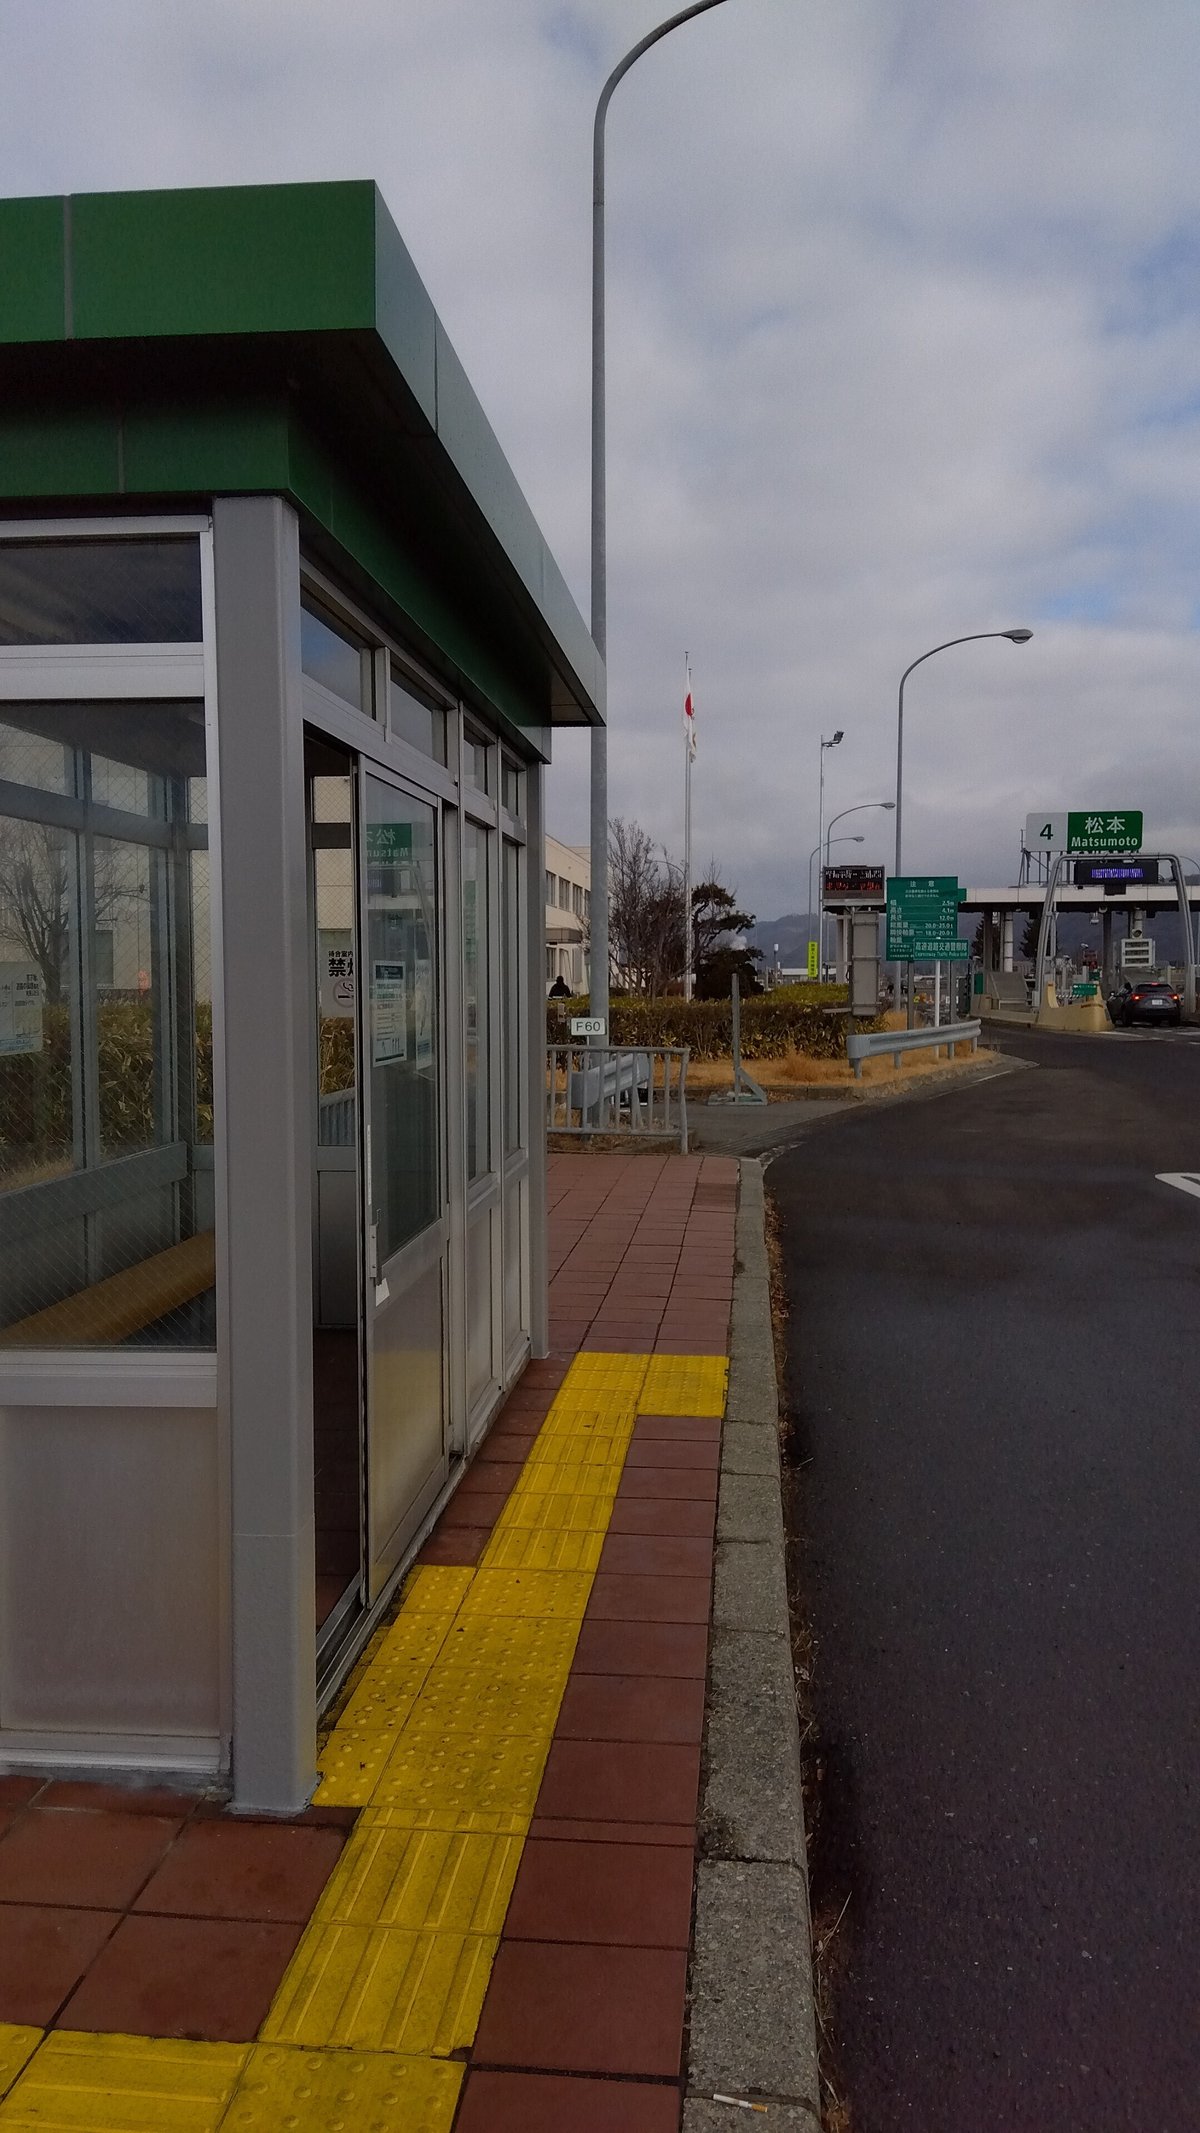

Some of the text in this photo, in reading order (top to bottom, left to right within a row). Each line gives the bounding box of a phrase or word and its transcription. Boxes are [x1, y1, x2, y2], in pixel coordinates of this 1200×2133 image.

[1039, 823, 1054, 840] 4
[1085, 816, 1126, 834] 松本
[1071, 836, 1138, 847] Matsumoto
[576, 1021, 601, 1032] F60
